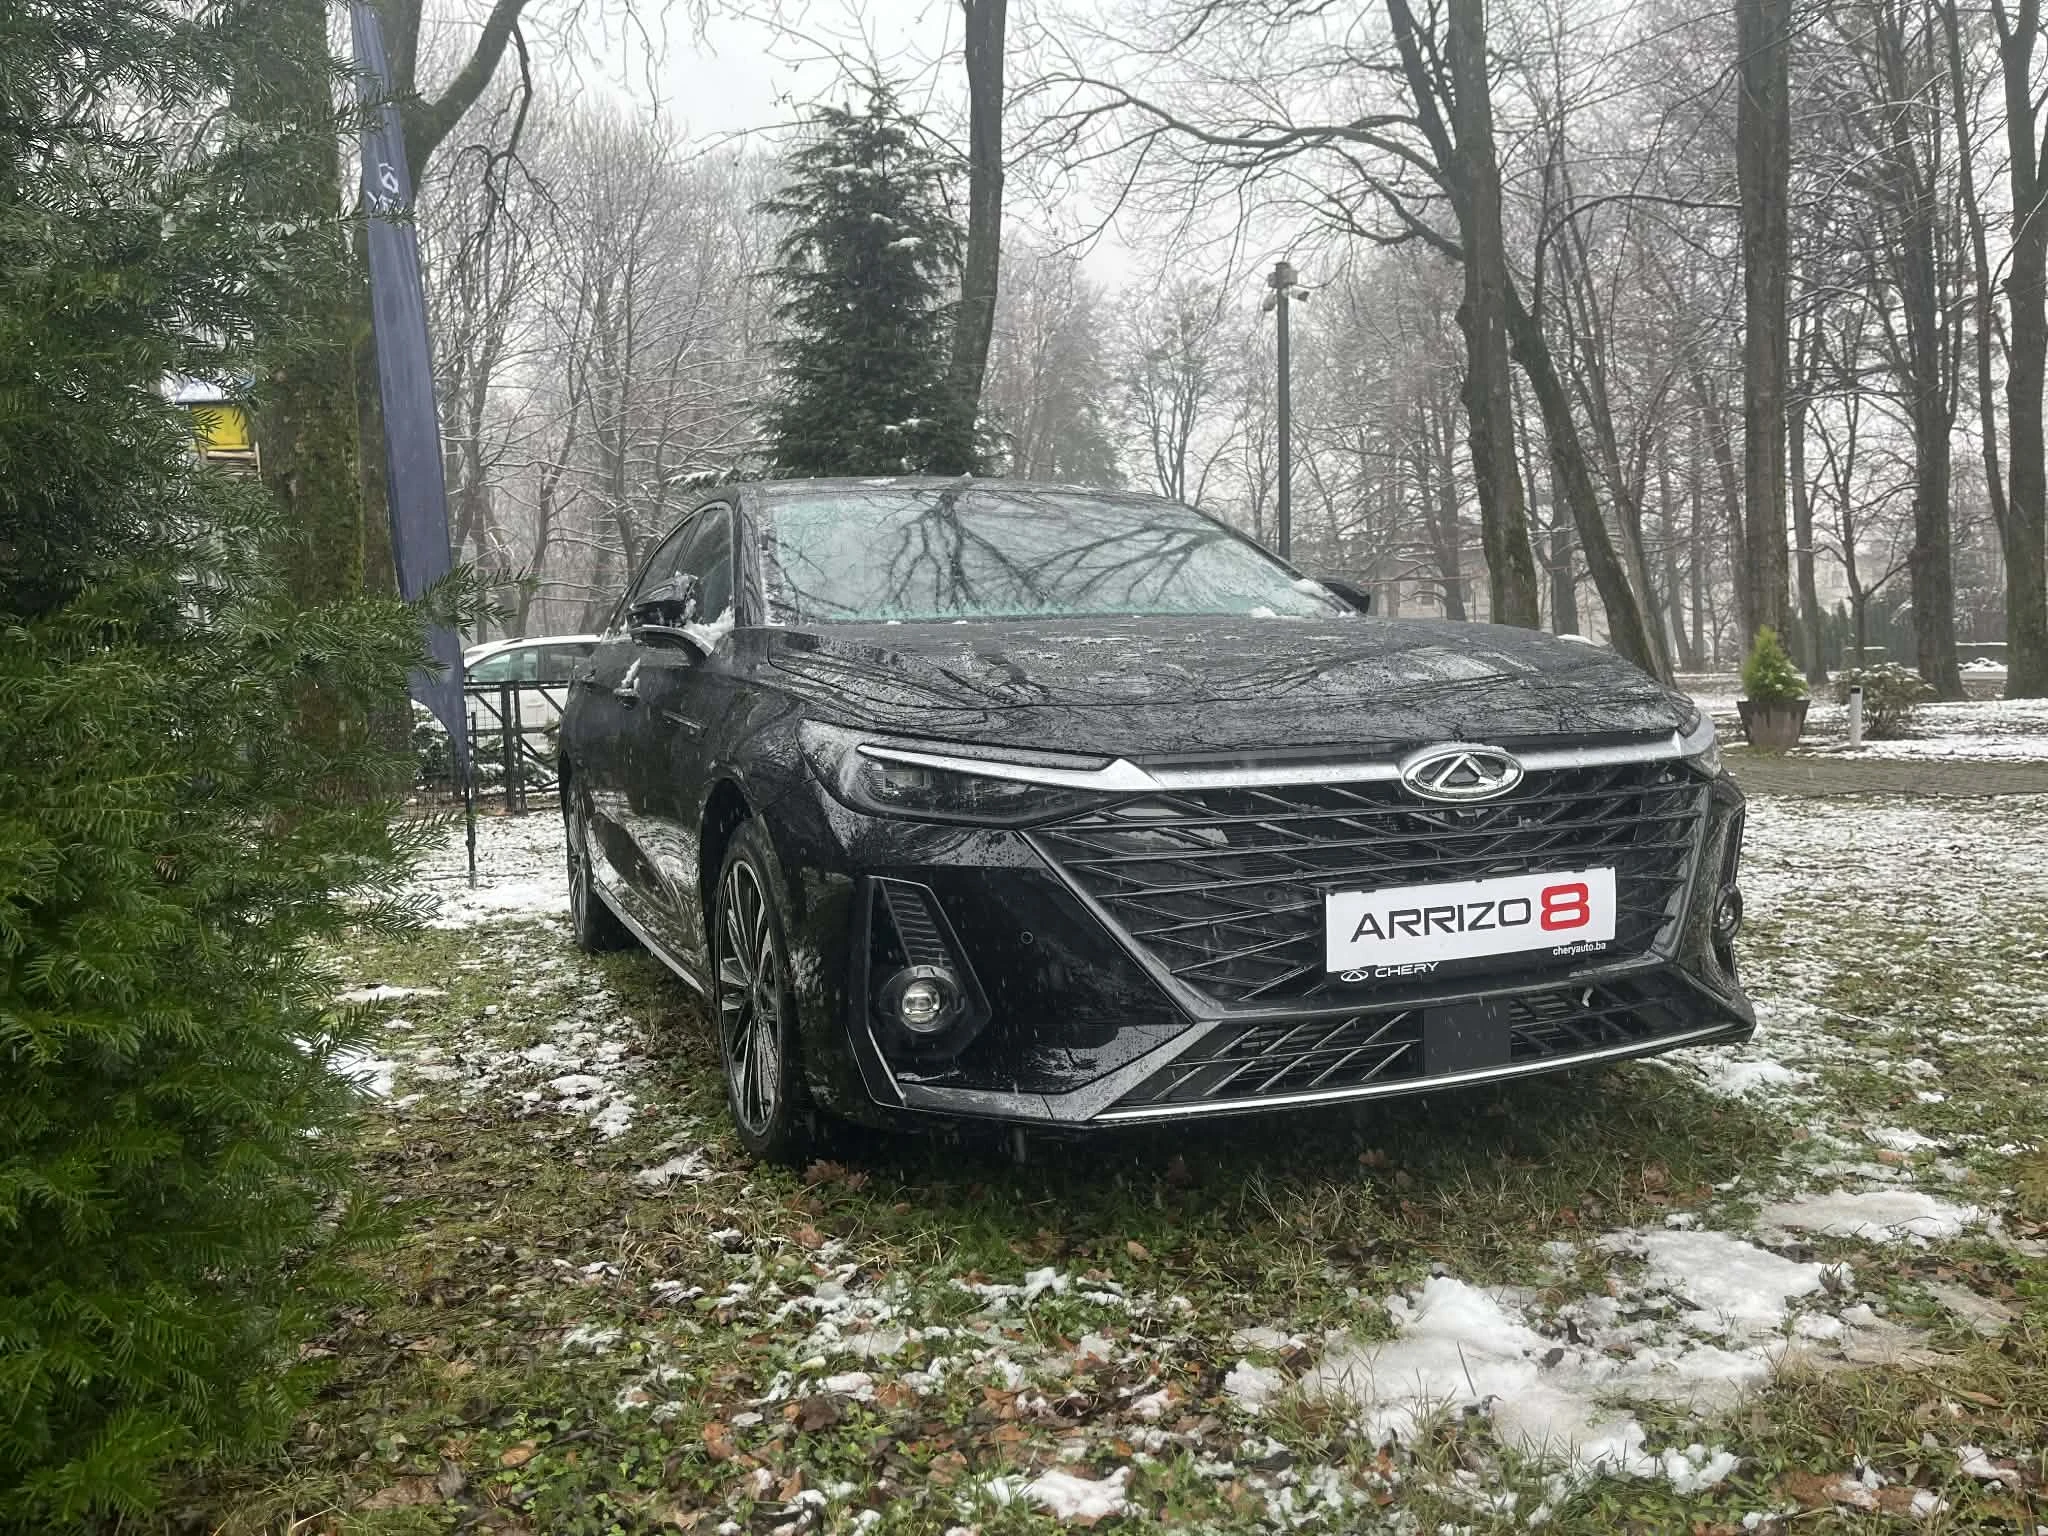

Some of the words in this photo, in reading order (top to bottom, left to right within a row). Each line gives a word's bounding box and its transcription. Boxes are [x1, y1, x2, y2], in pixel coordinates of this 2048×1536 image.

[1350, 897, 1532, 943] ARRIZO
[1540, 882, 1590, 932] 8
[1552, 941, 1607, 956] cheryauto.ba
[1374, 961, 1440, 978] CHERY
